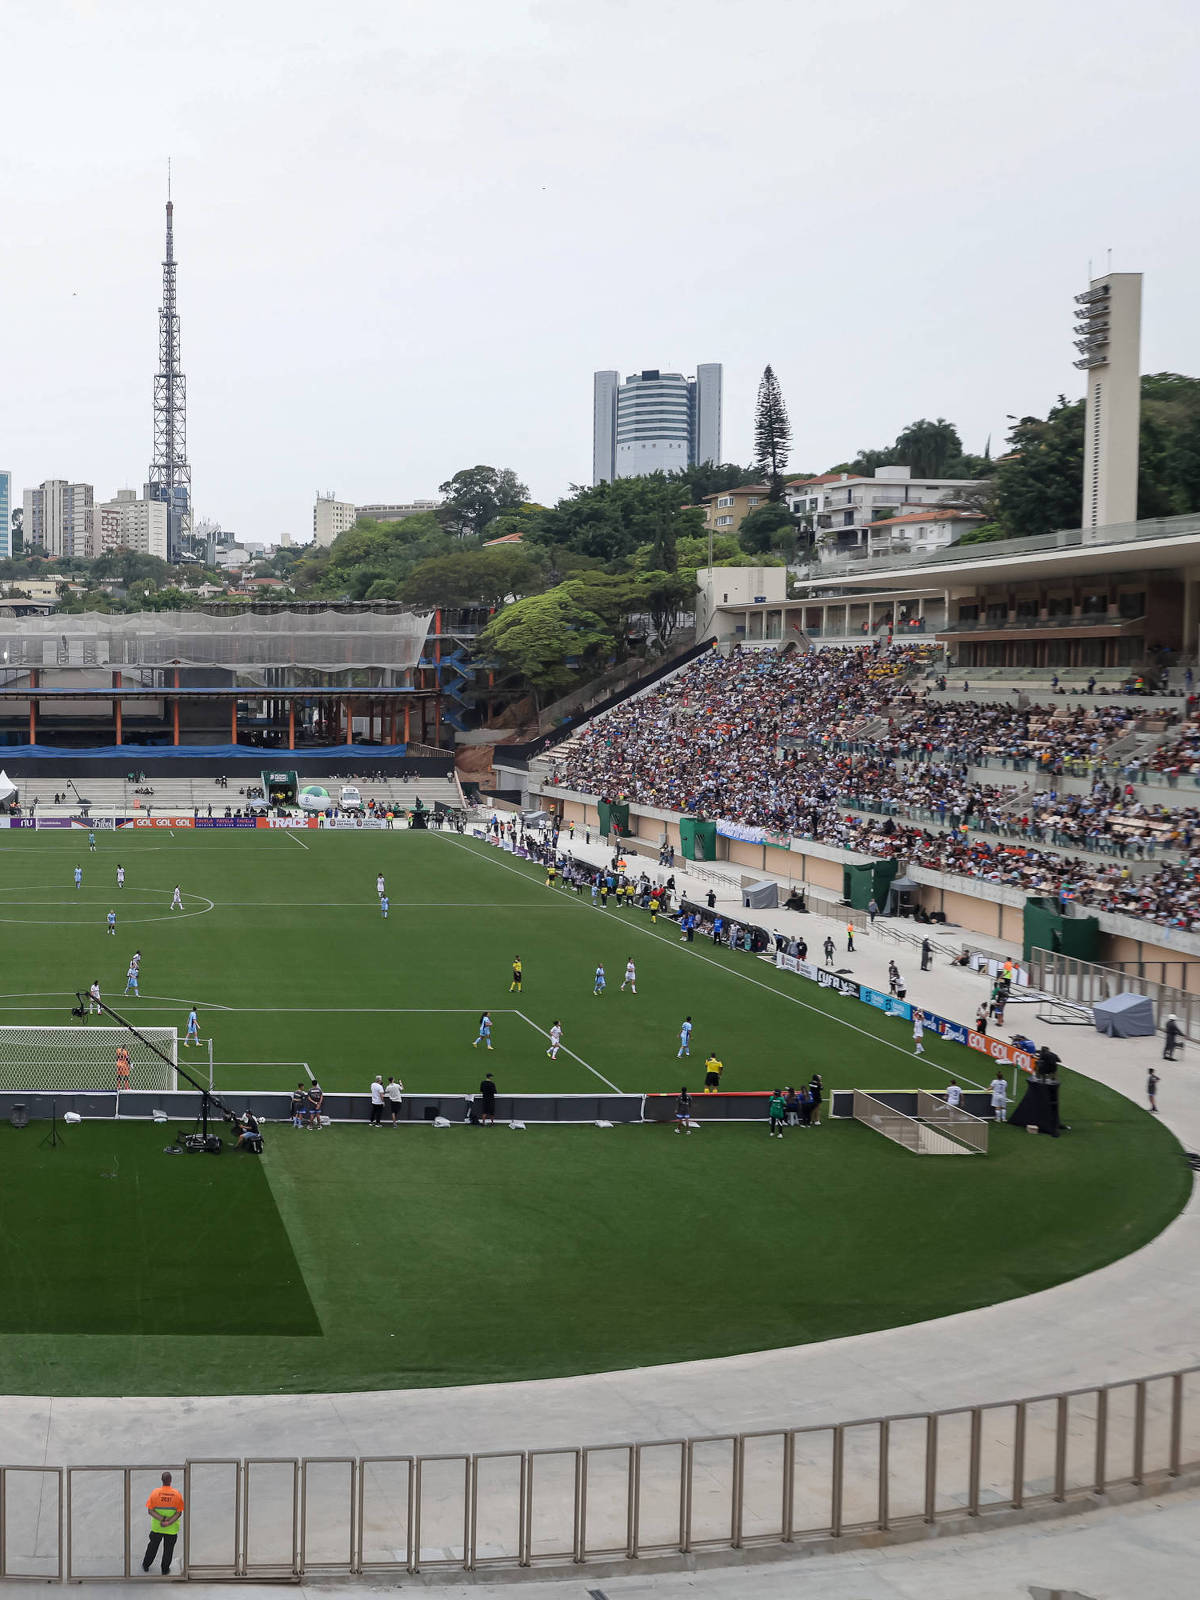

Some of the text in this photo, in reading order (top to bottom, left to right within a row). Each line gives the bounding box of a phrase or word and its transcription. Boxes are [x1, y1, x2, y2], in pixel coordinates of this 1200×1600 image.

[136, 818, 151, 827] GOL
[156, 818, 172, 827] GOL
[176, 818, 192, 827] GOL
[968, 1033, 987, 1053] GOL
[990, 1042, 1009, 1061] GOL
[1013, 1051, 1033, 1072] GOL
